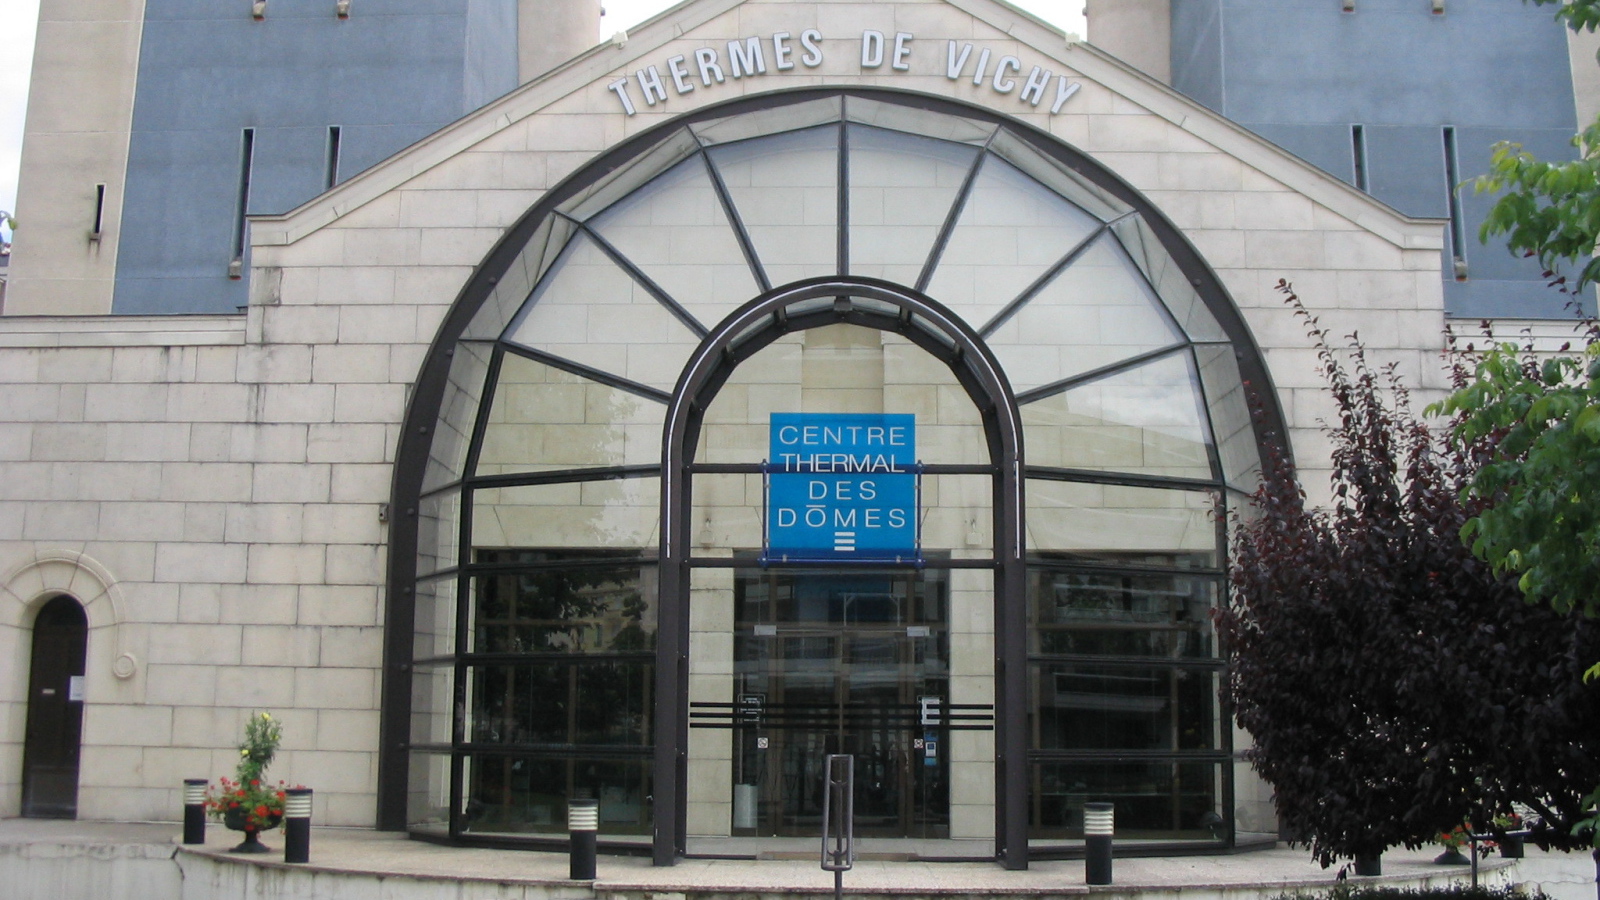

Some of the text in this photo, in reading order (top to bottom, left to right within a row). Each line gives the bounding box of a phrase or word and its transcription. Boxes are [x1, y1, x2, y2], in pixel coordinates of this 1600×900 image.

[608, 29, 1082, 116] THERMES DE VICHY
[779, 426, 905, 446] CENTRE
[779, 453, 905, 473] THERMAL
[809, 480, 877, 500] DES
